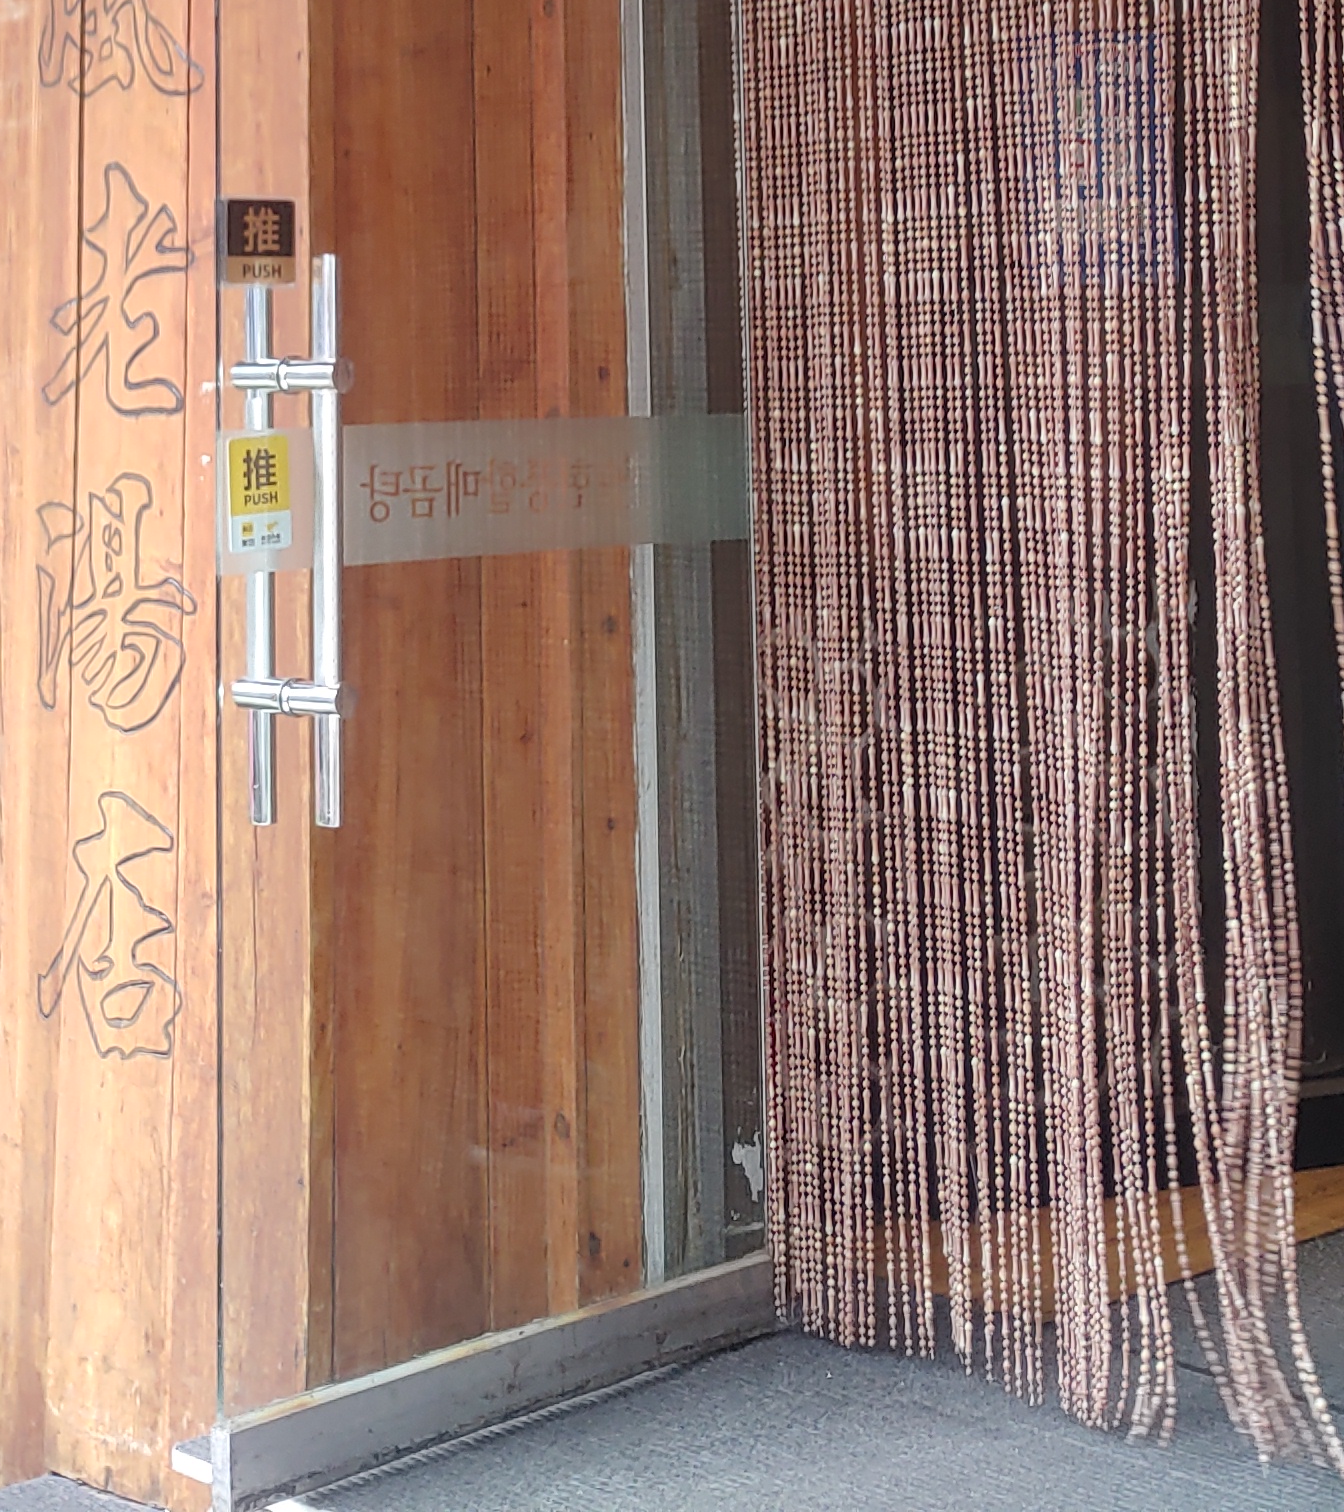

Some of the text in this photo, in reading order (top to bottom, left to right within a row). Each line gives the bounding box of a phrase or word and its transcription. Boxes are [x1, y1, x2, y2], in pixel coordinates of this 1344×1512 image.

[243, 206, 281, 253] 推
[242, 263, 282, 279] PUSH
[243, 448, 278, 491] 推
[244, 491, 279, 506] PUSH
